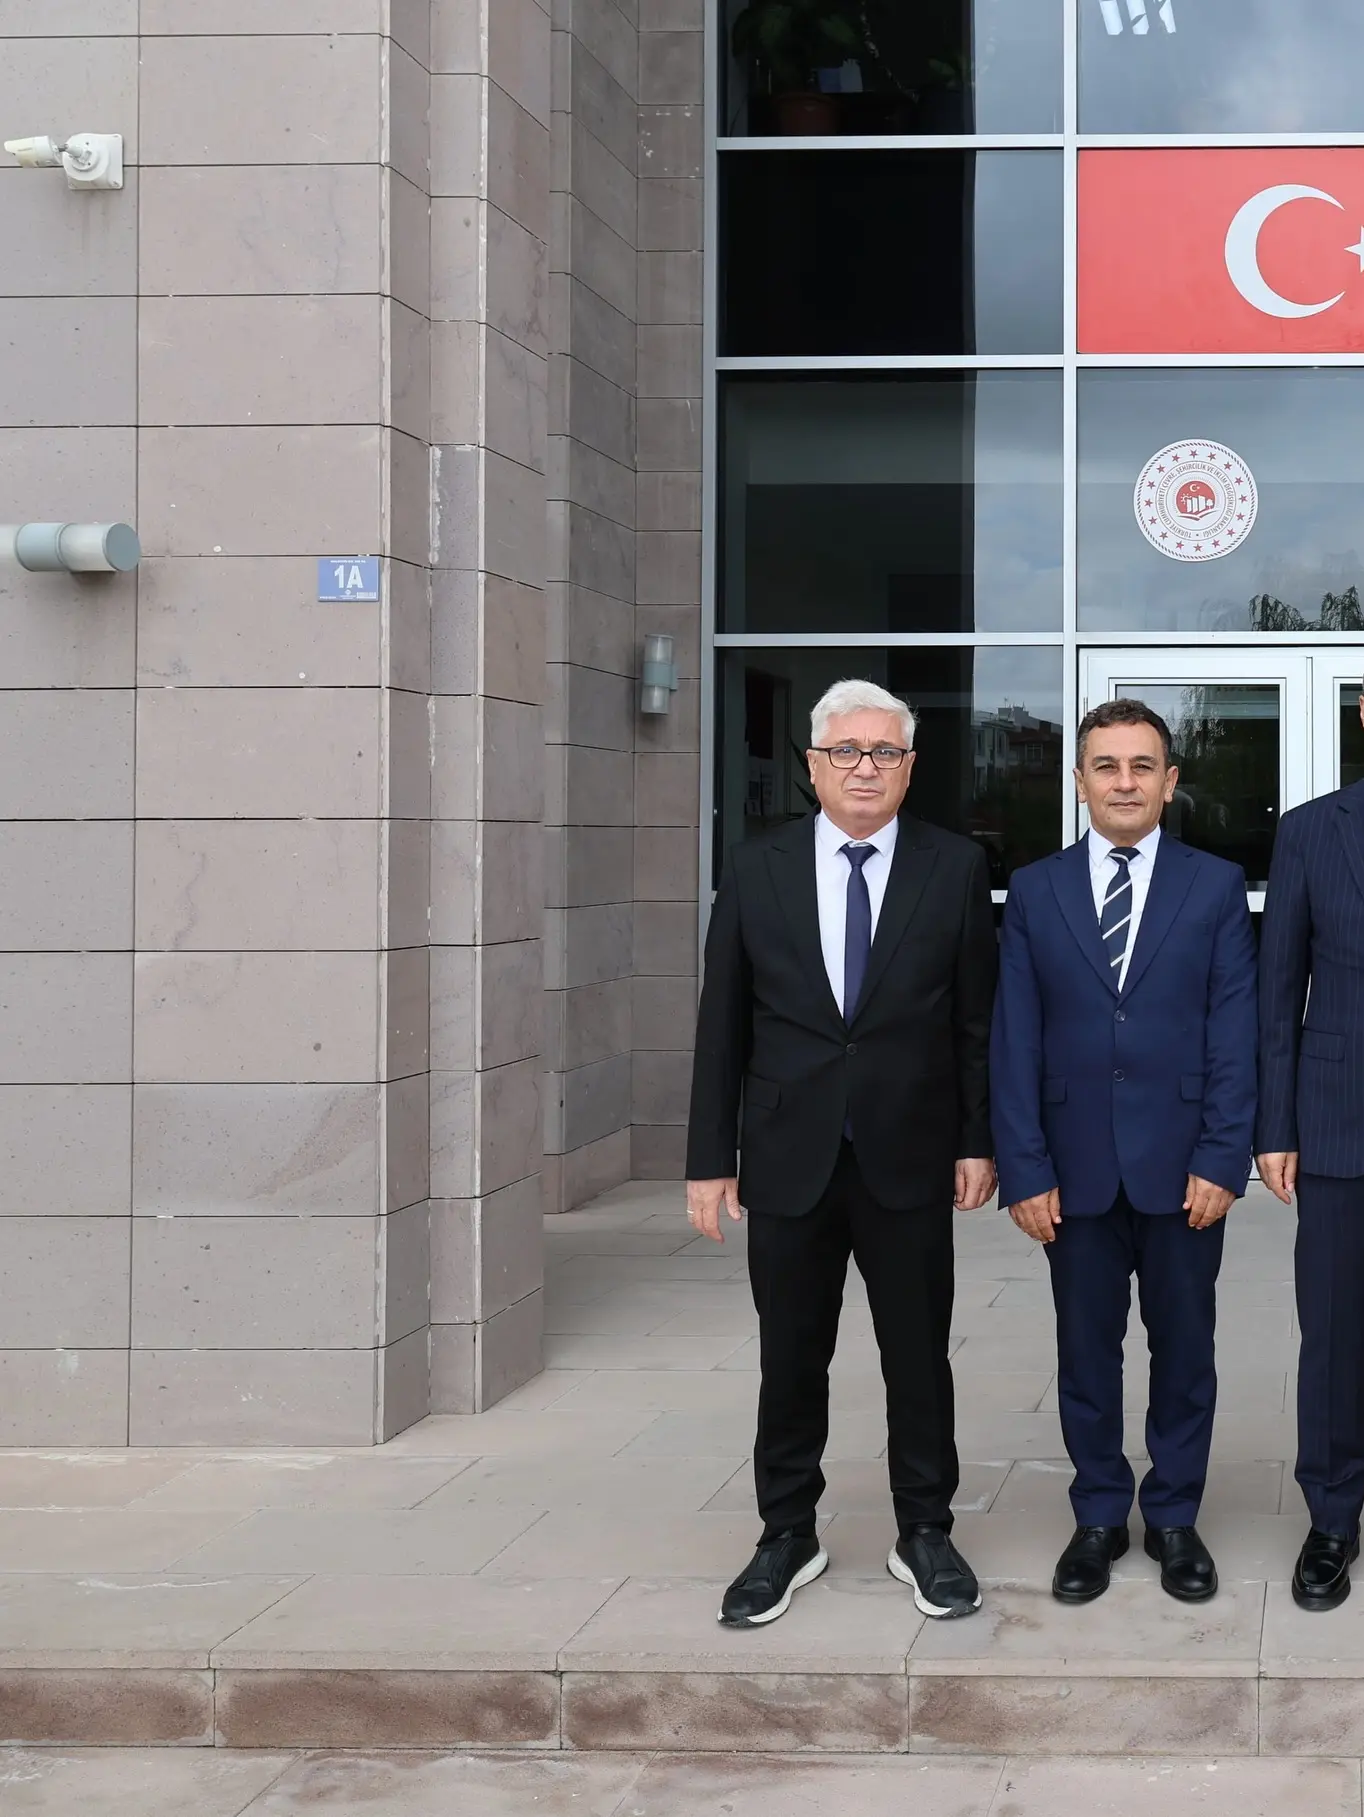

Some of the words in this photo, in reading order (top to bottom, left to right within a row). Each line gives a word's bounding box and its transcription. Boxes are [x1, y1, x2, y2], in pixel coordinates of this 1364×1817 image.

[1175, 463, 1206, 474] ŞEHİRCİLİK
[1207, 465, 1214, 473] VE
[1214, 469, 1228, 483] İKLİM
[1158, 487, 1171, 525] CUMHURİYETİ
[1224, 483, 1234, 516] DEĞİŞİKLİĞİ
[1169, 522, 1192, 538] TÜRKİYE
[1203, 517, 1228, 538] BAKANLIĞI
[334, 564, 364, 589] 1A
